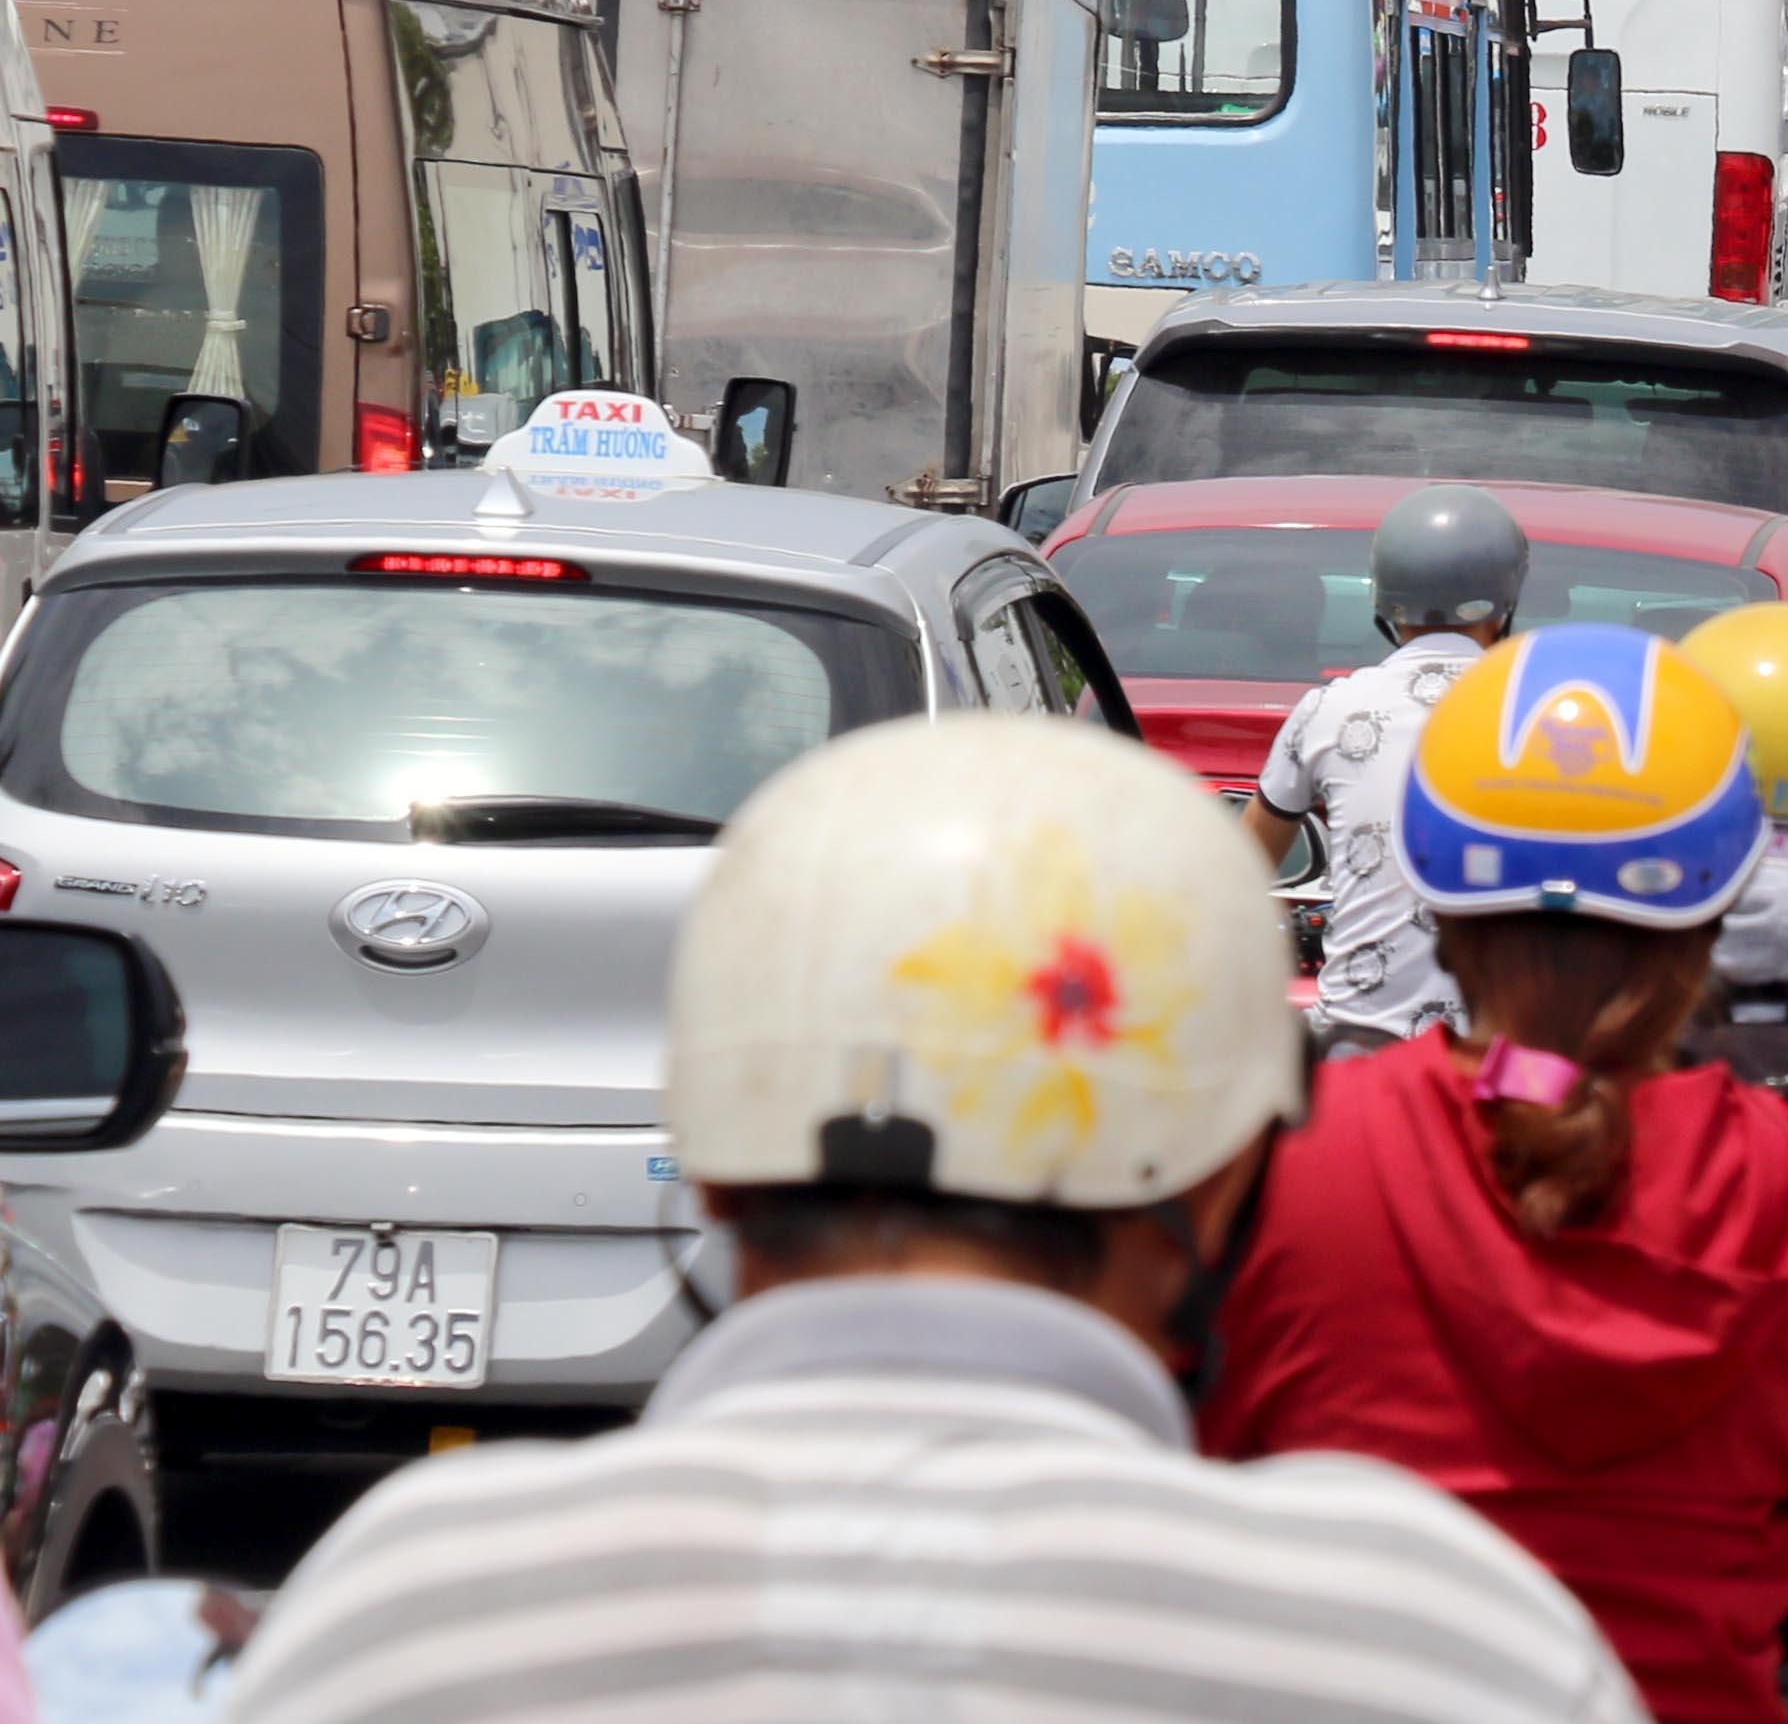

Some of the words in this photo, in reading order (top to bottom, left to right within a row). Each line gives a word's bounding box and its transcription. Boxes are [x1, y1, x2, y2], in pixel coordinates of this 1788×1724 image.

[1109, 247, 1262, 284] SAMCO
[554, 401, 643, 423] TAXI
[328, 1238, 438, 1306] 79A
[286, 1306, 482, 1374] 156.35
